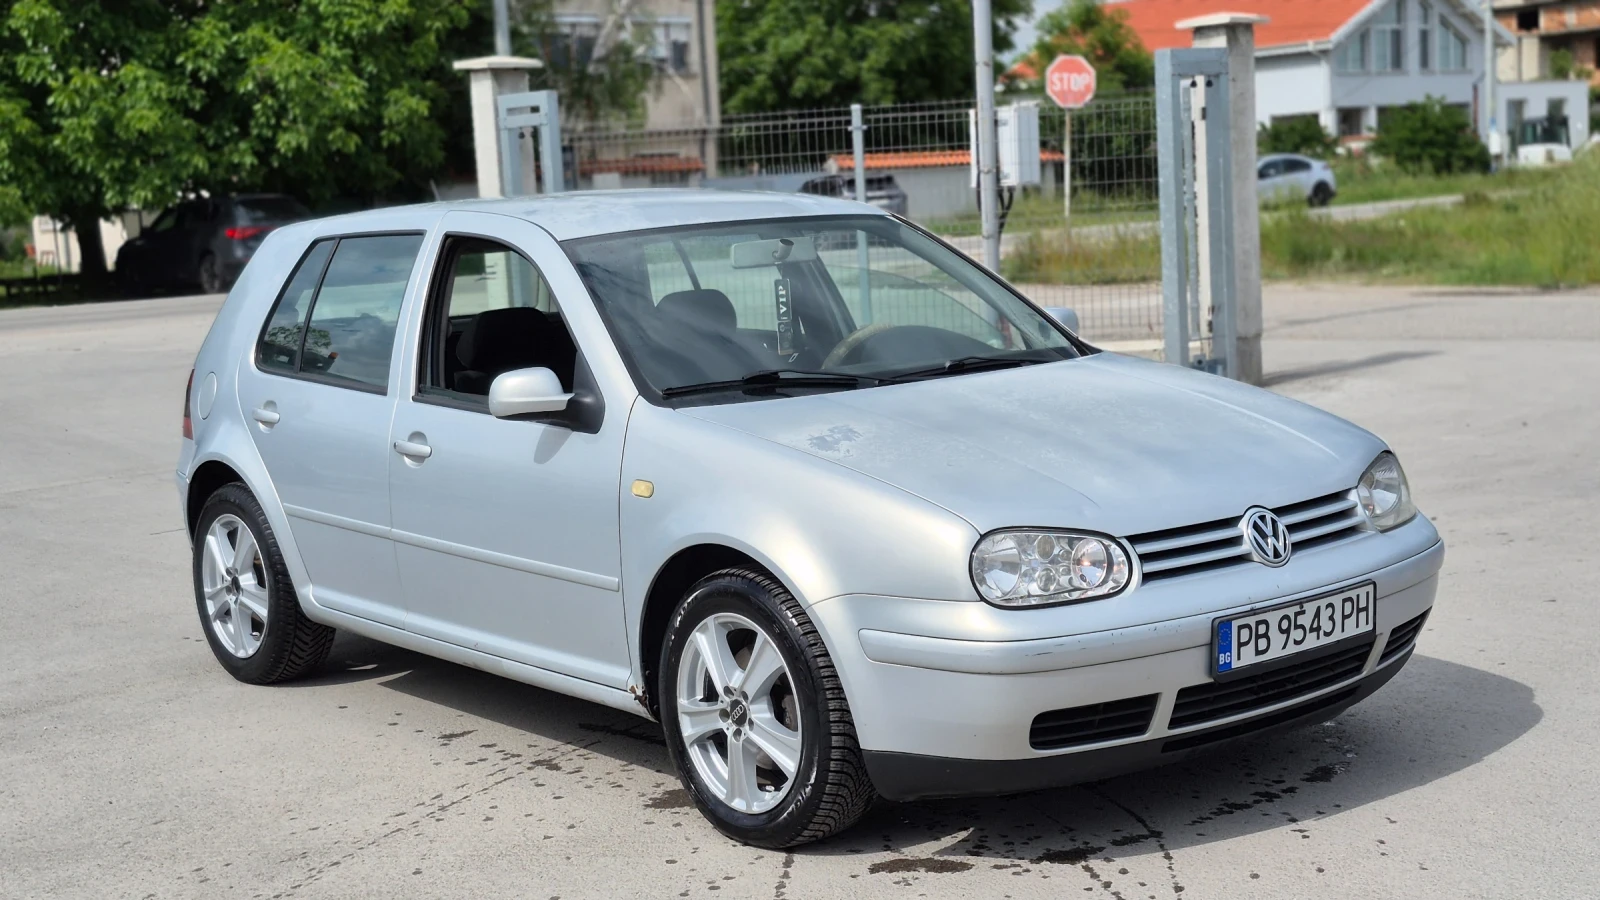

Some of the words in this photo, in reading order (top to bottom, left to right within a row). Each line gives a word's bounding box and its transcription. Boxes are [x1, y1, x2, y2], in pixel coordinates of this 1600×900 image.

[1051, 72, 1090, 92] STOP
[1237, 619, 1271, 661] PB
[1278, 602, 1336, 650] 9543
[1341, 591, 1370, 633] PH
[1218, 652, 1231, 665] BG
